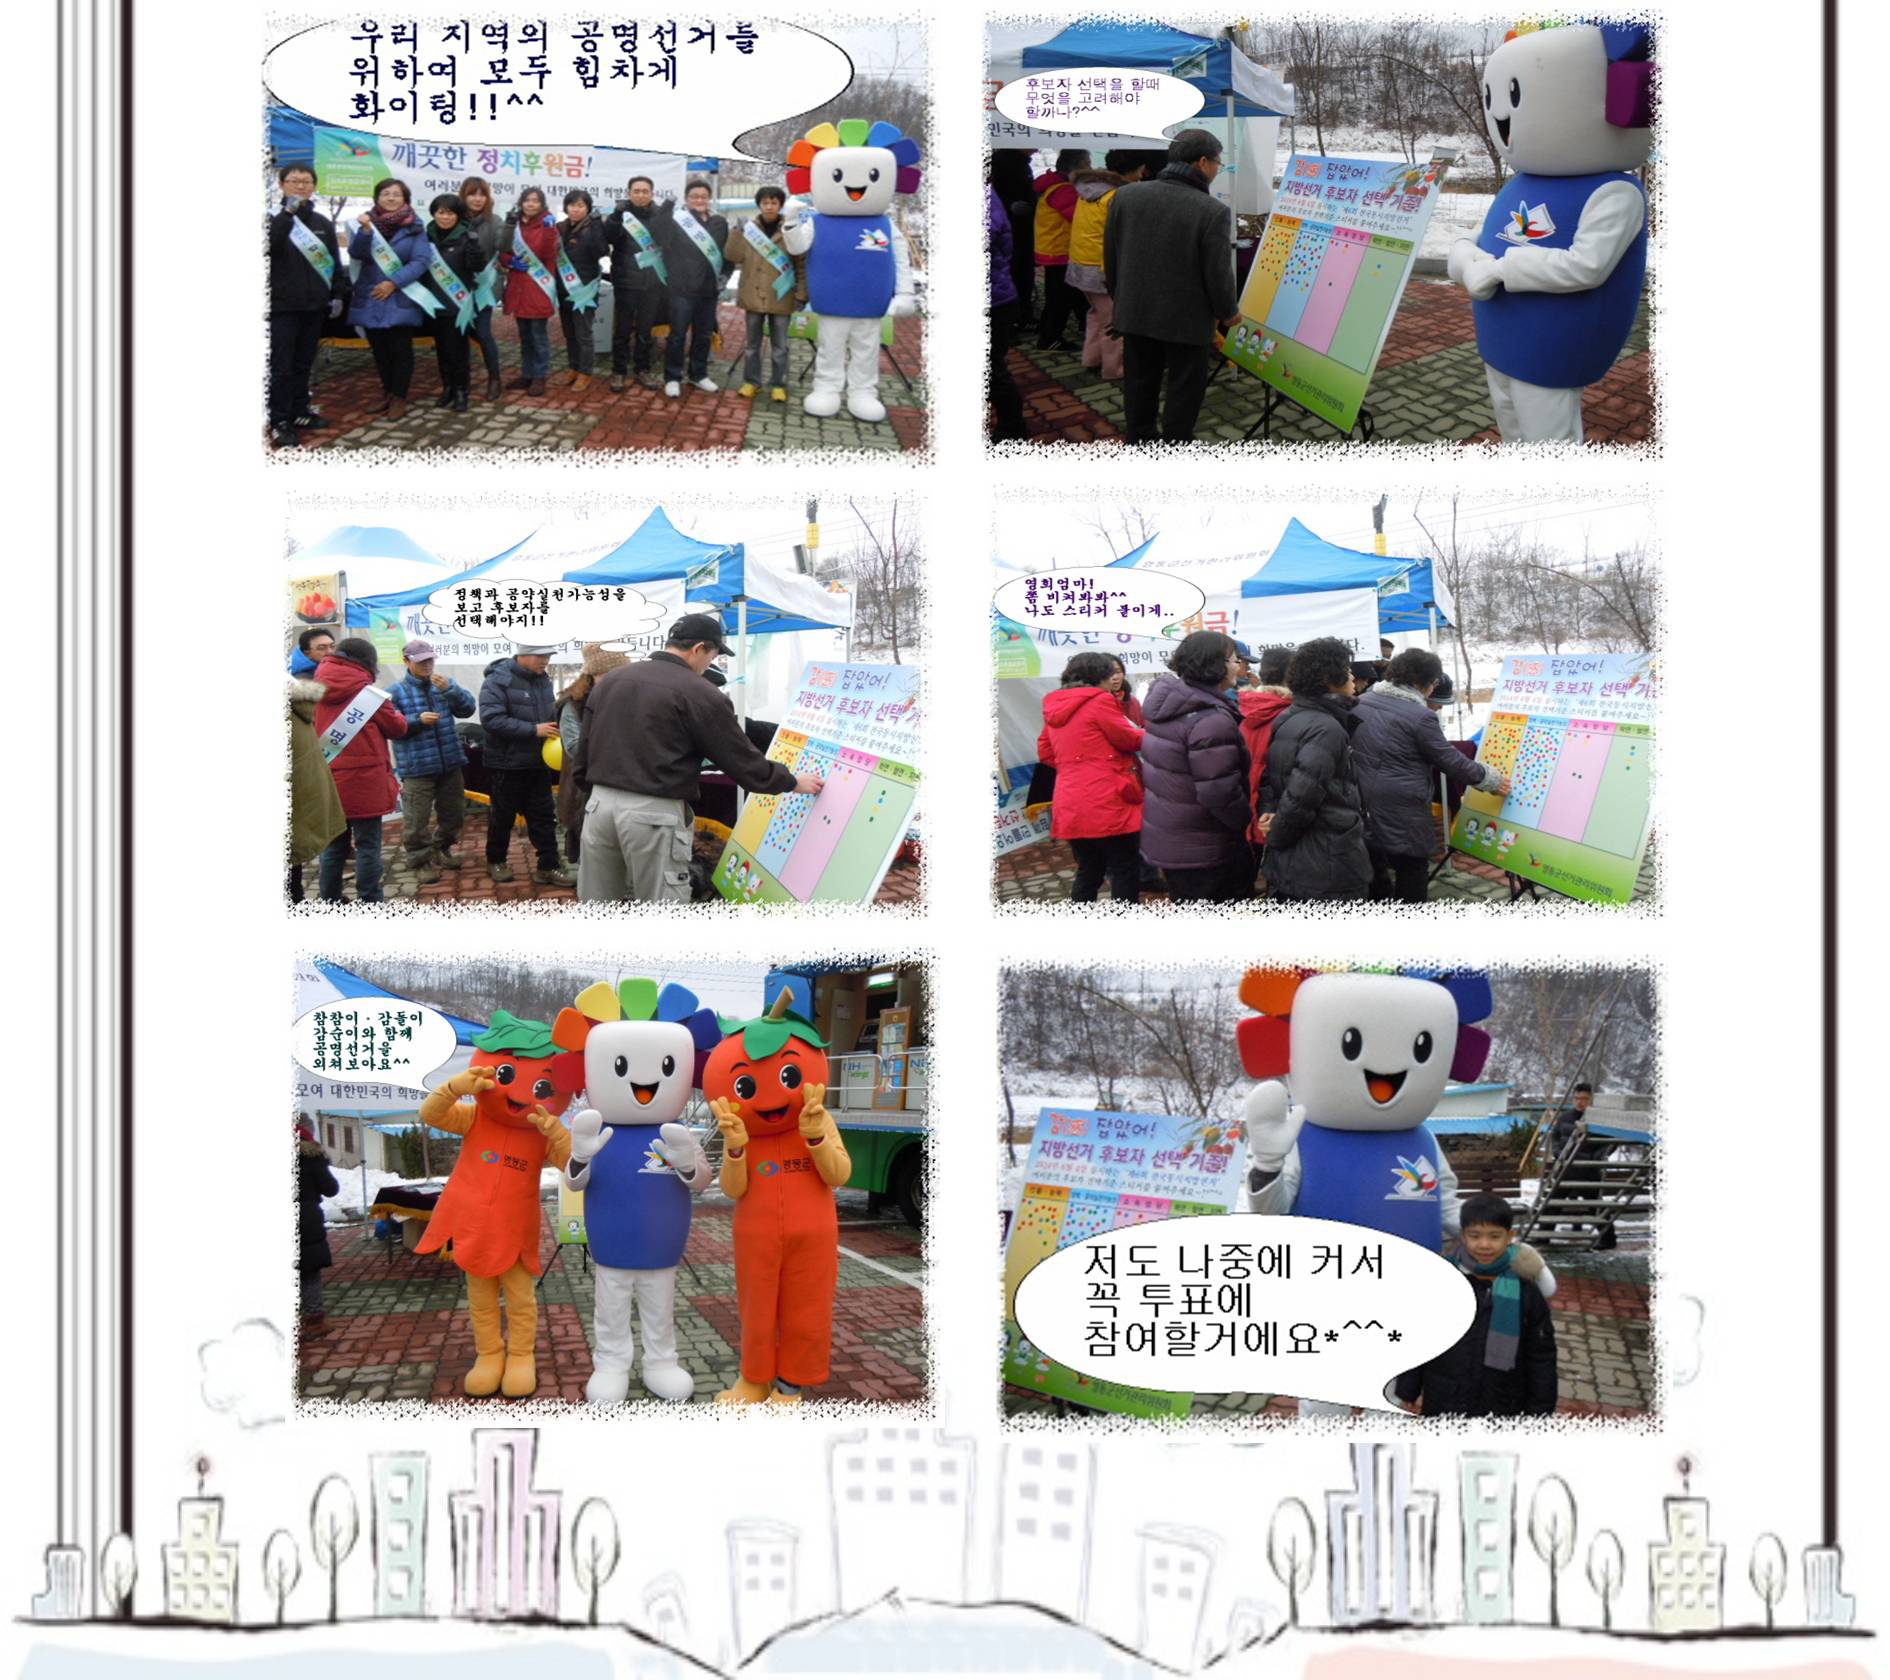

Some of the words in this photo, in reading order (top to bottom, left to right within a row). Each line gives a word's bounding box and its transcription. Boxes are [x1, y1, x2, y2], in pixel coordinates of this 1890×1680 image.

[392, 143, 467, 171] 깨끗한
[477, 148, 593, 178] 정치후원금!
[424, 179, 462, 193] 여러분
[1285, 180, 1322, 199] 지방선거
[1325, 186, 1359, 204] 후보자
[1362, 190, 1389, 209] 선택
[463, 643, 489, 656] 희망이
[493, 642, 512, 655] 모여
[1502, 679, 1549, 694] 지방선거
[1552, 681, 1594, 696] 후보자
[1600, 682, 1631, 698] 선택
[796, 690, 835, 711] 지방선거
[836, 697, 873, 719] 후보자
[875, 702, 904, 724] 선택
[297, 1083, 323, 1098] 모여
[330, 1084, 392, 1100] 대한민국의
[1038, 1140, 1094, 1162] 지방선거
[1099, 1146, 1145, 1168] 후보자
[1152, 1150, 1186, 1170] 선택
[1189, 1153, 1228, 1174] 기준!
